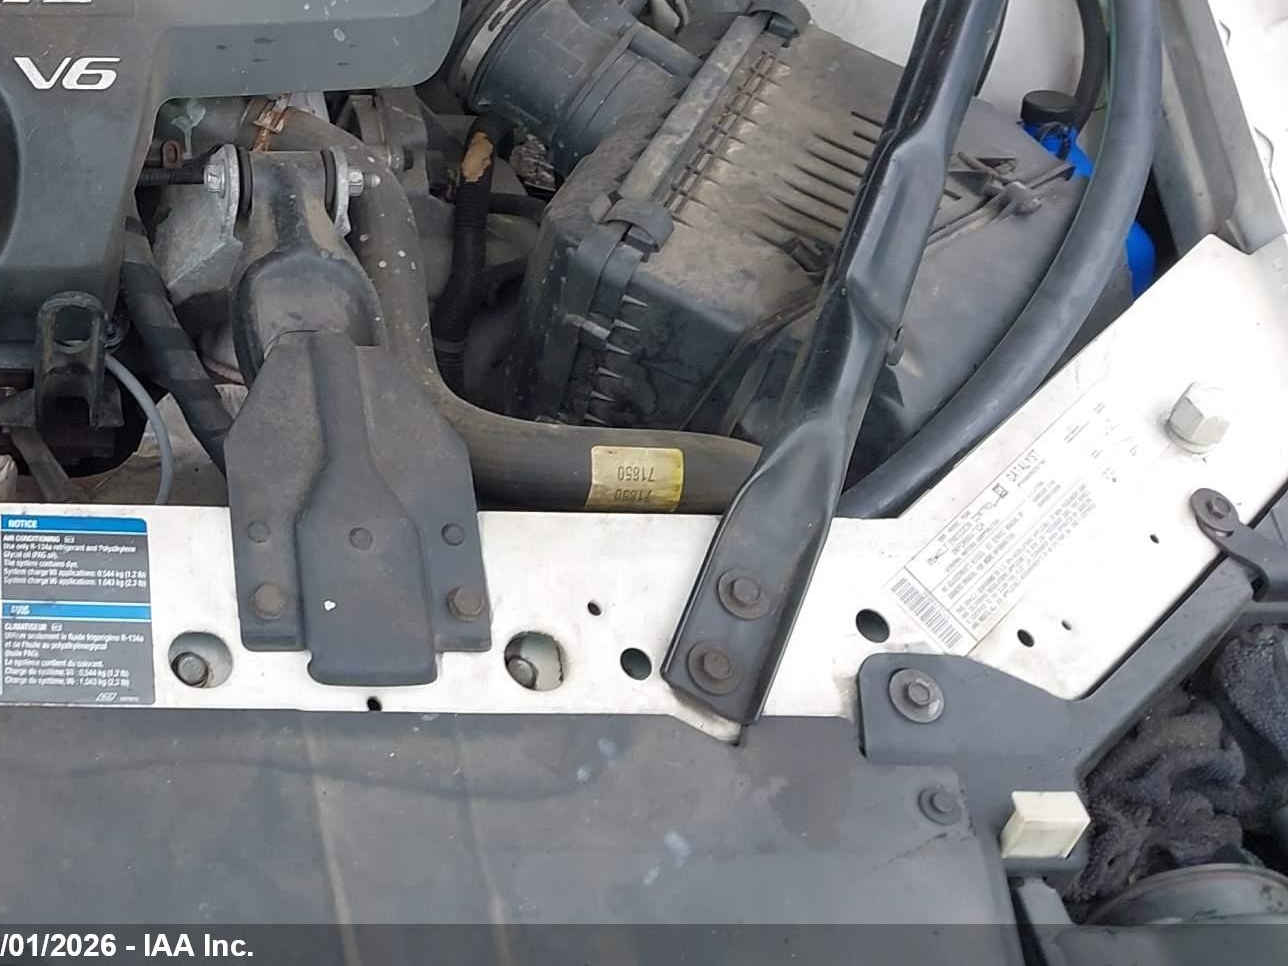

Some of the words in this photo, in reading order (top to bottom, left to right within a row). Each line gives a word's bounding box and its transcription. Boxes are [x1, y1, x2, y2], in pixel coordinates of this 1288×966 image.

[14, 56, 121, 90] V6
[618, 465, 656, 482] 71850
[1005, 448, 1041, 484] CATALYST
[8, 520, 38, 528] NOTICE
